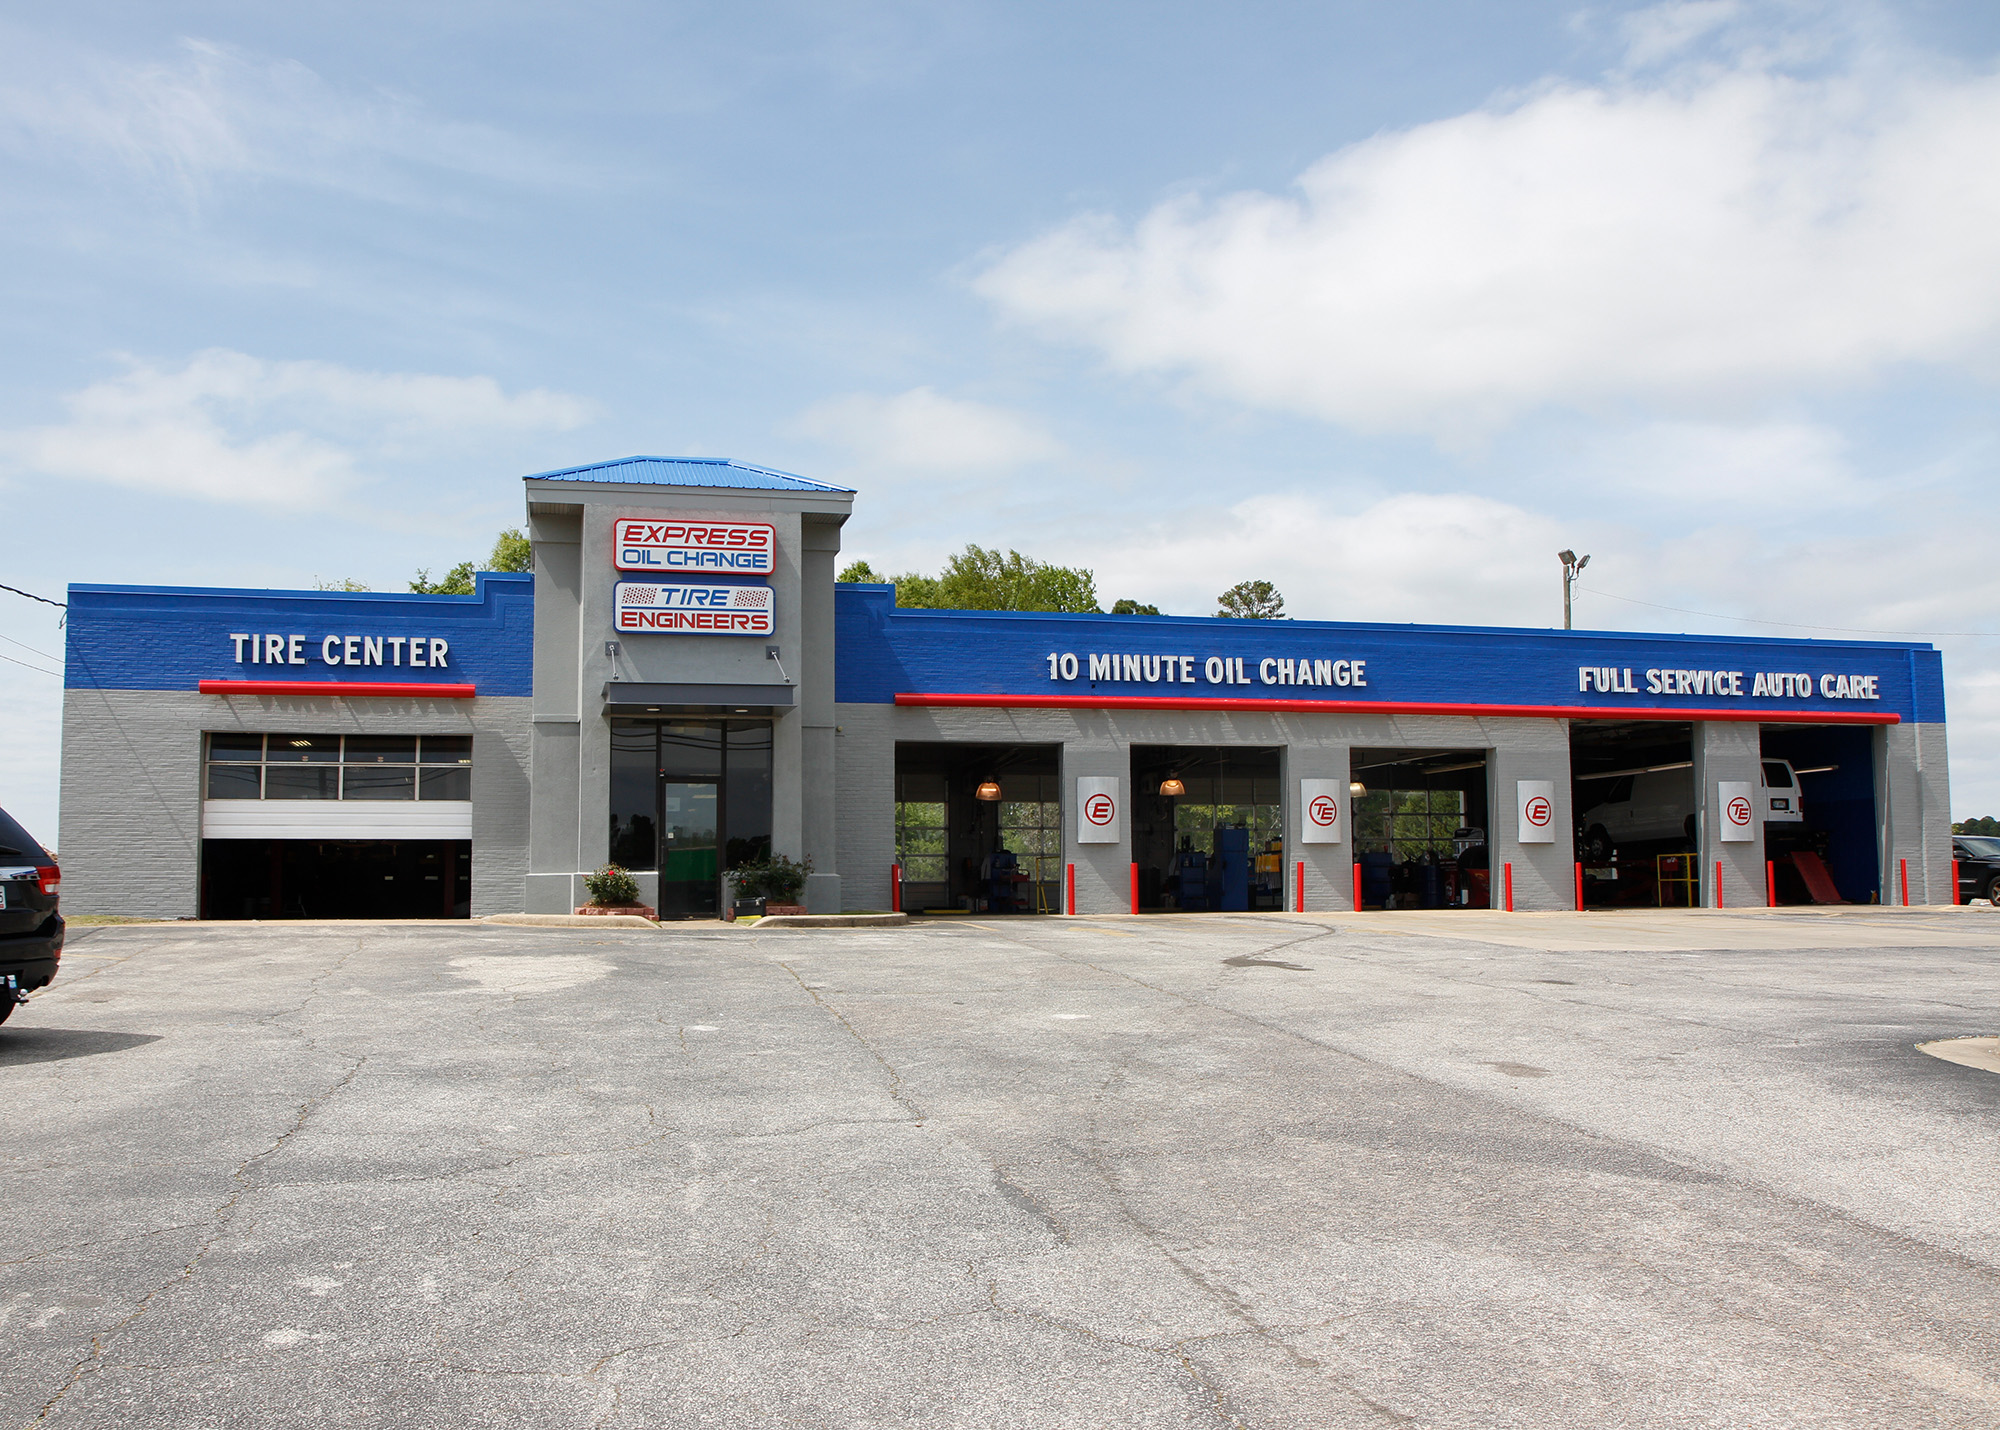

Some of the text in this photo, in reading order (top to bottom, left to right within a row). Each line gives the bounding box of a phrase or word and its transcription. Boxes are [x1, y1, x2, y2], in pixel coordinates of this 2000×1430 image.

[623, 525, 770, 547] EXPRESS
[622, 549, 768, 569] OIL CHANGE
[661, 588, 730, 606] TIRE
[621, 611, 769, 630] ENGINEERS
[229, 633, 449, 668] TIRE CENTER
[1046, 652, 1367, 687] 10 MINUTE OIL CHANGE
[1578, 666, 1880, 700] FULL SERVICE AUTO CARE
[1092, 802, 1111, 819] E
[1313, 802, 1334, 820] TE
[1532, 804, 1548, 820] E
[1731, 803, 1749, 820] TE
